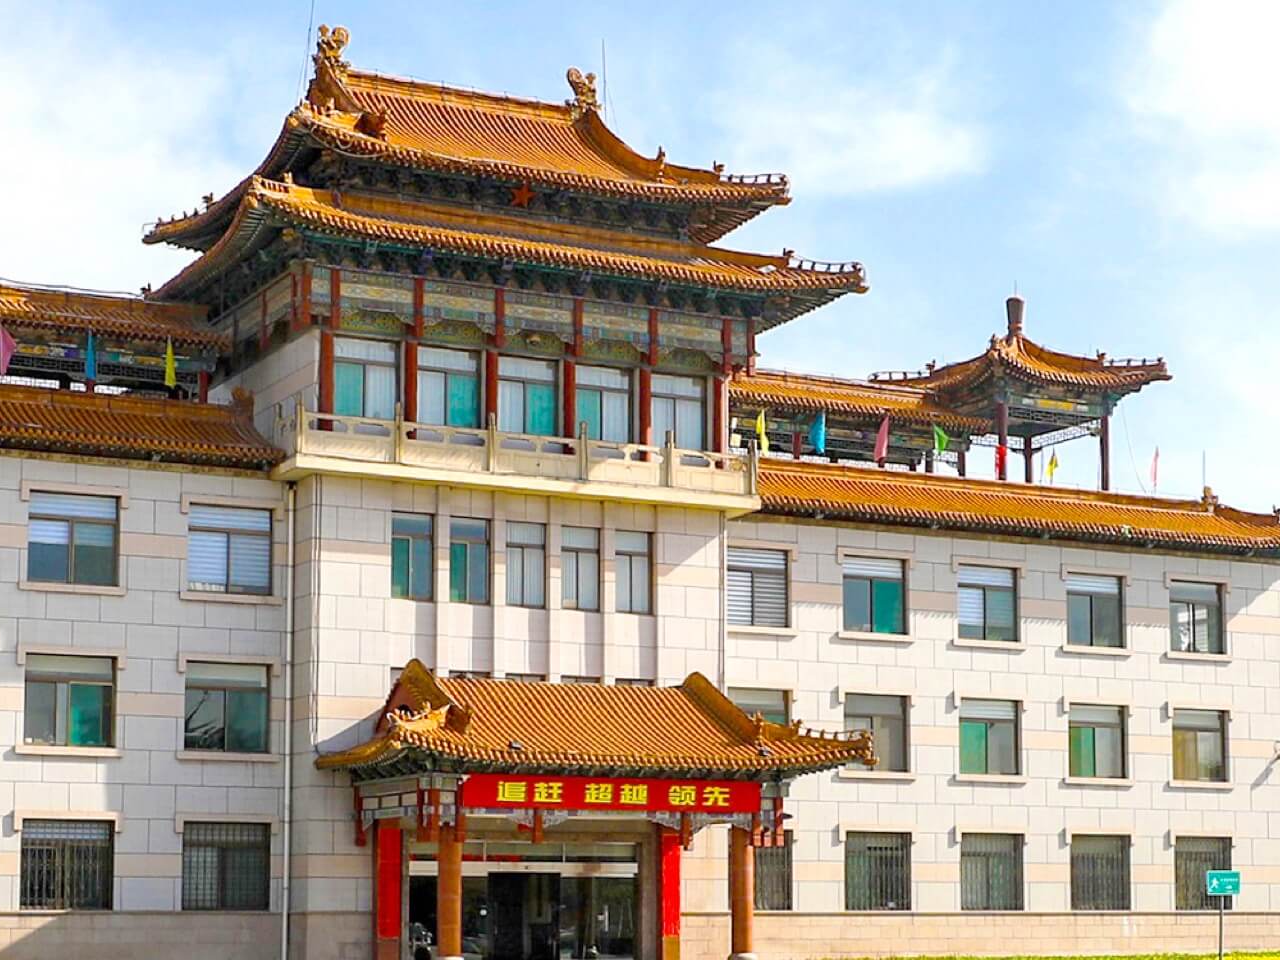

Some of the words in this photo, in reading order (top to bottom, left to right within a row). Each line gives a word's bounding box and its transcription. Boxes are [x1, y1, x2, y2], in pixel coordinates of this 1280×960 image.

[496, 781, 563, 803] 追赶
[584, 783, 648, 805] 超越
[668, 785, 731, 807] 领先
